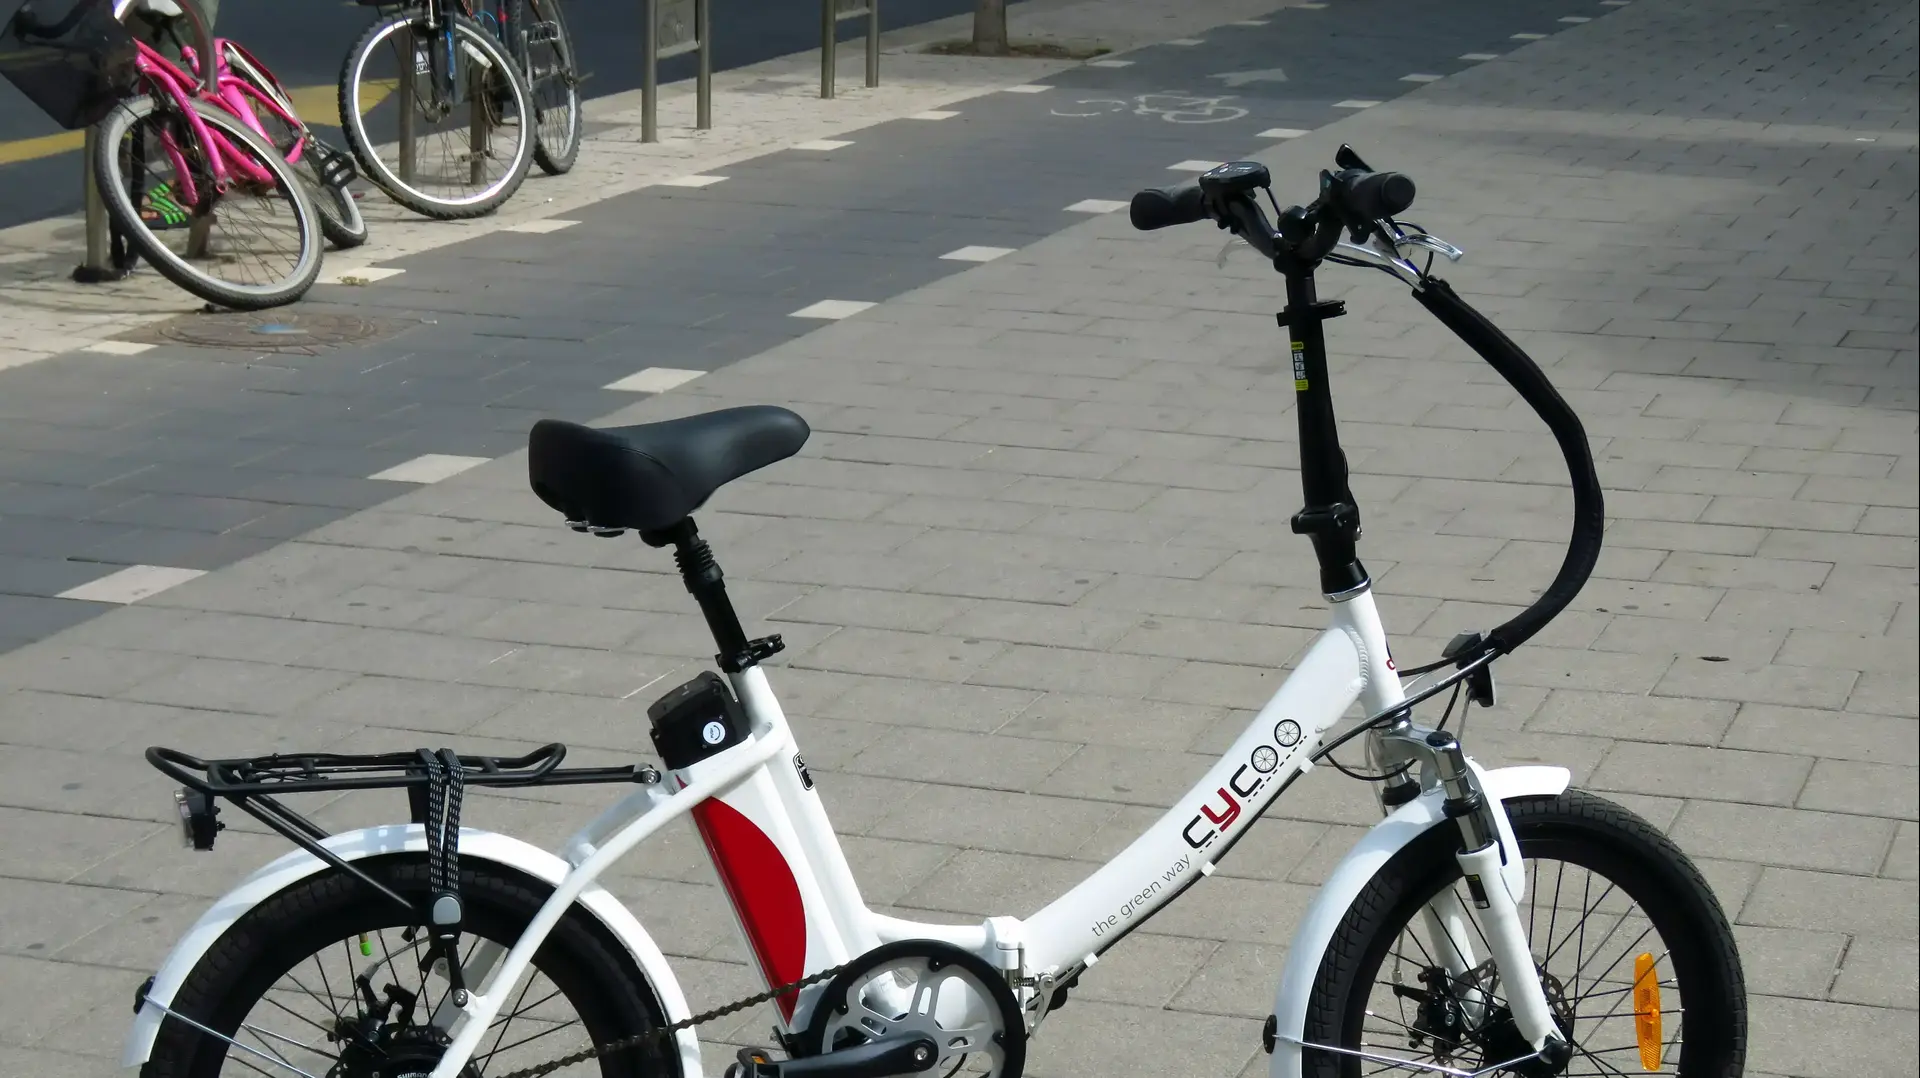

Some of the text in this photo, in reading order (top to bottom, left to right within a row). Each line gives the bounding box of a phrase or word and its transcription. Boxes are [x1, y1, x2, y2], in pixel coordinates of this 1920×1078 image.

[1092, 854, 1190, 937] the green way
